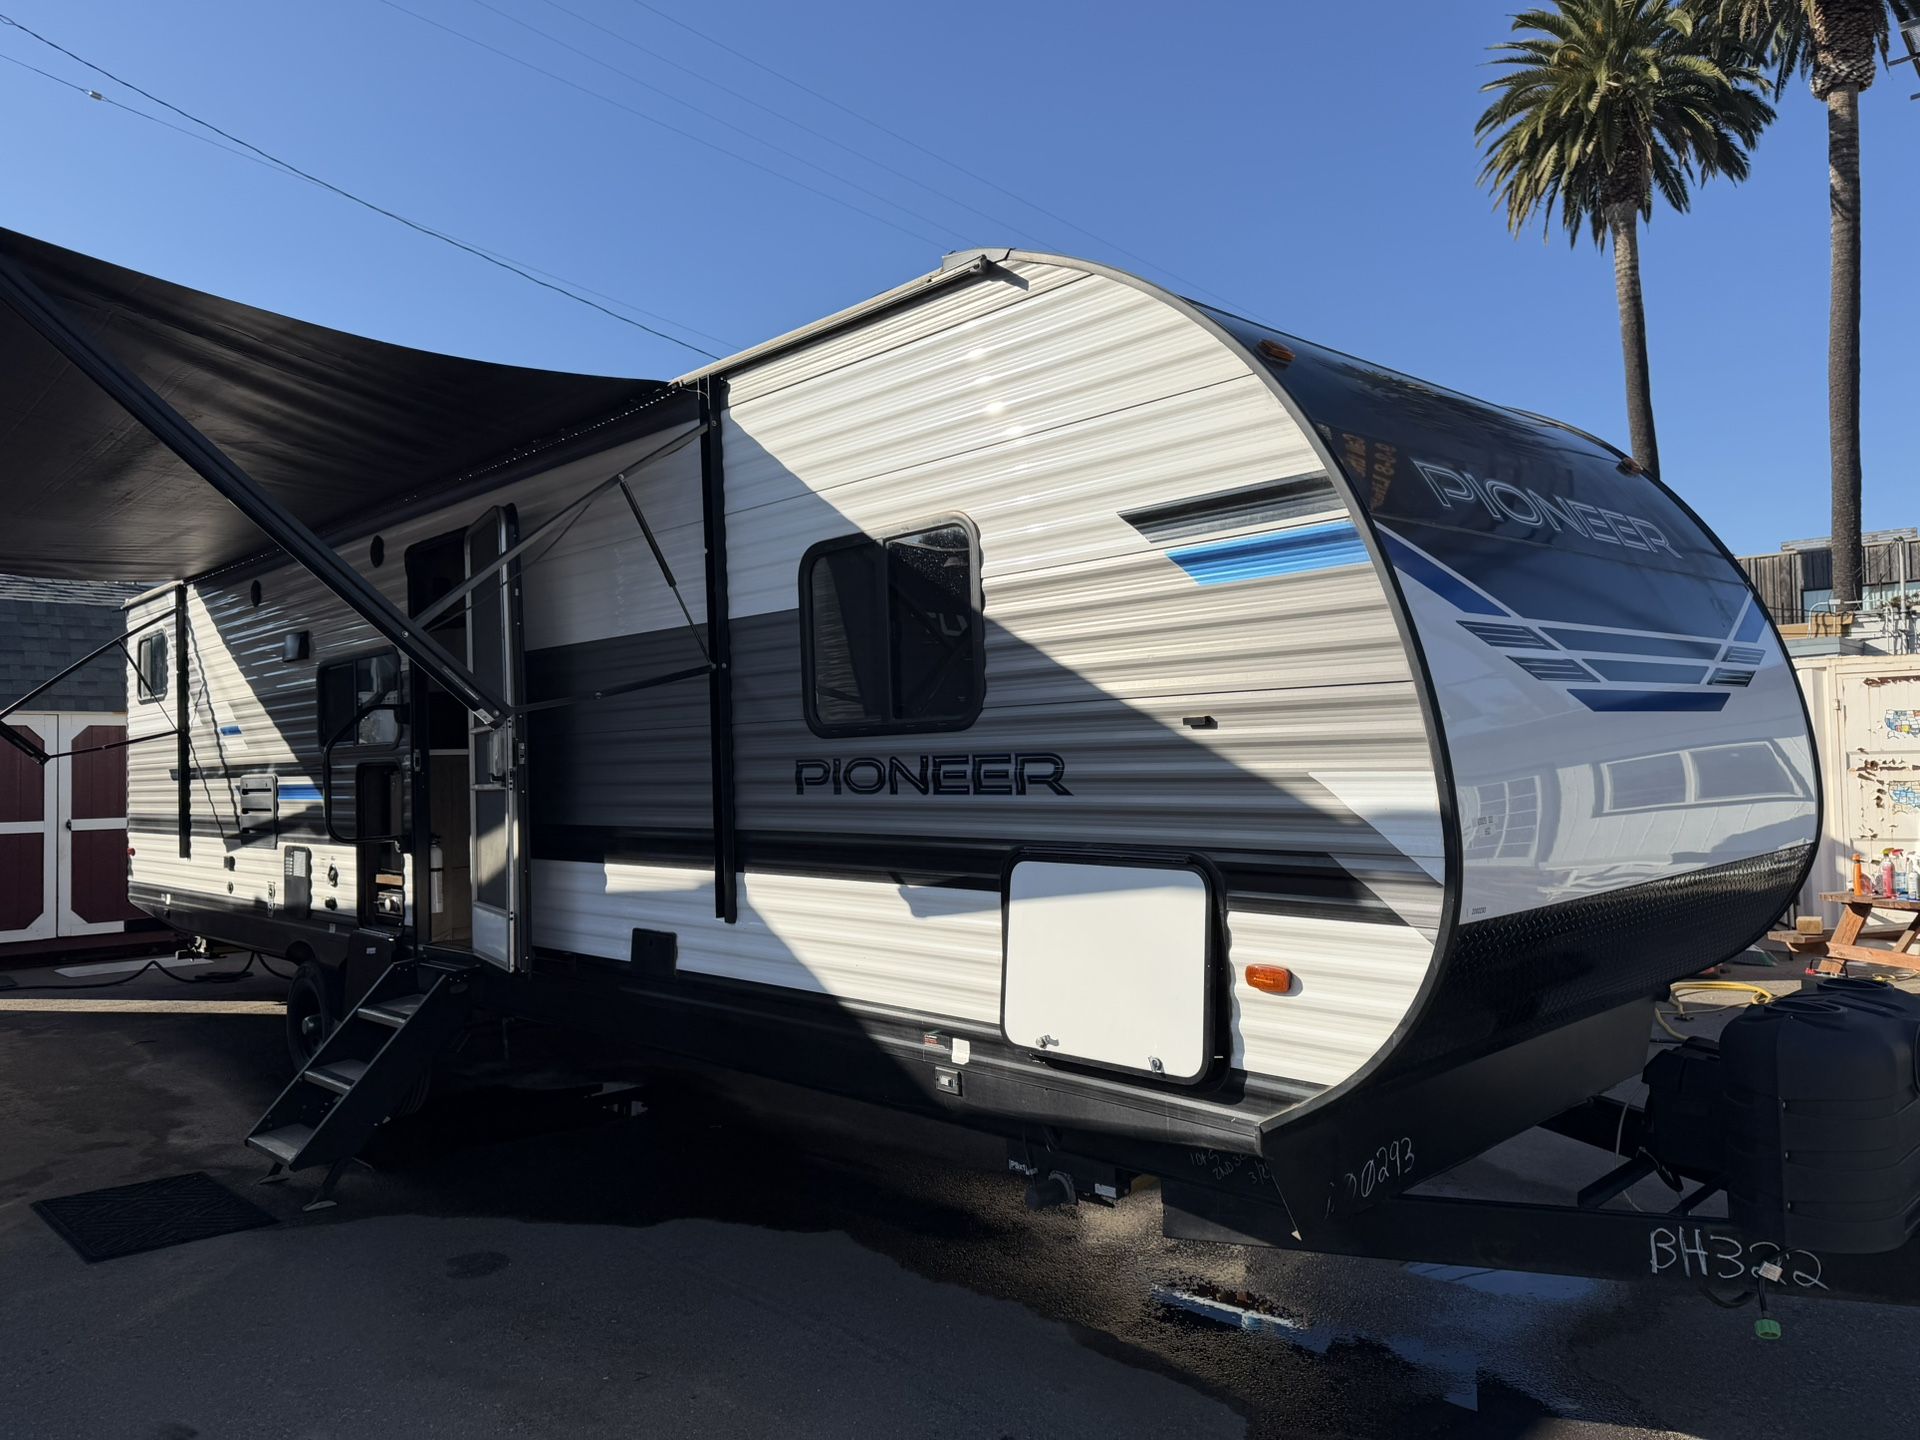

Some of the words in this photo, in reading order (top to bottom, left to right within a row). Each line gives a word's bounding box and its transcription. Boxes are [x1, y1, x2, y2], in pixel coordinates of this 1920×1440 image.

[1409, 457, 1683, 559] PIONEER
[795, 752, 1074, 797] PIONEER
[1650, 1225, 1831, 1292] BH322
